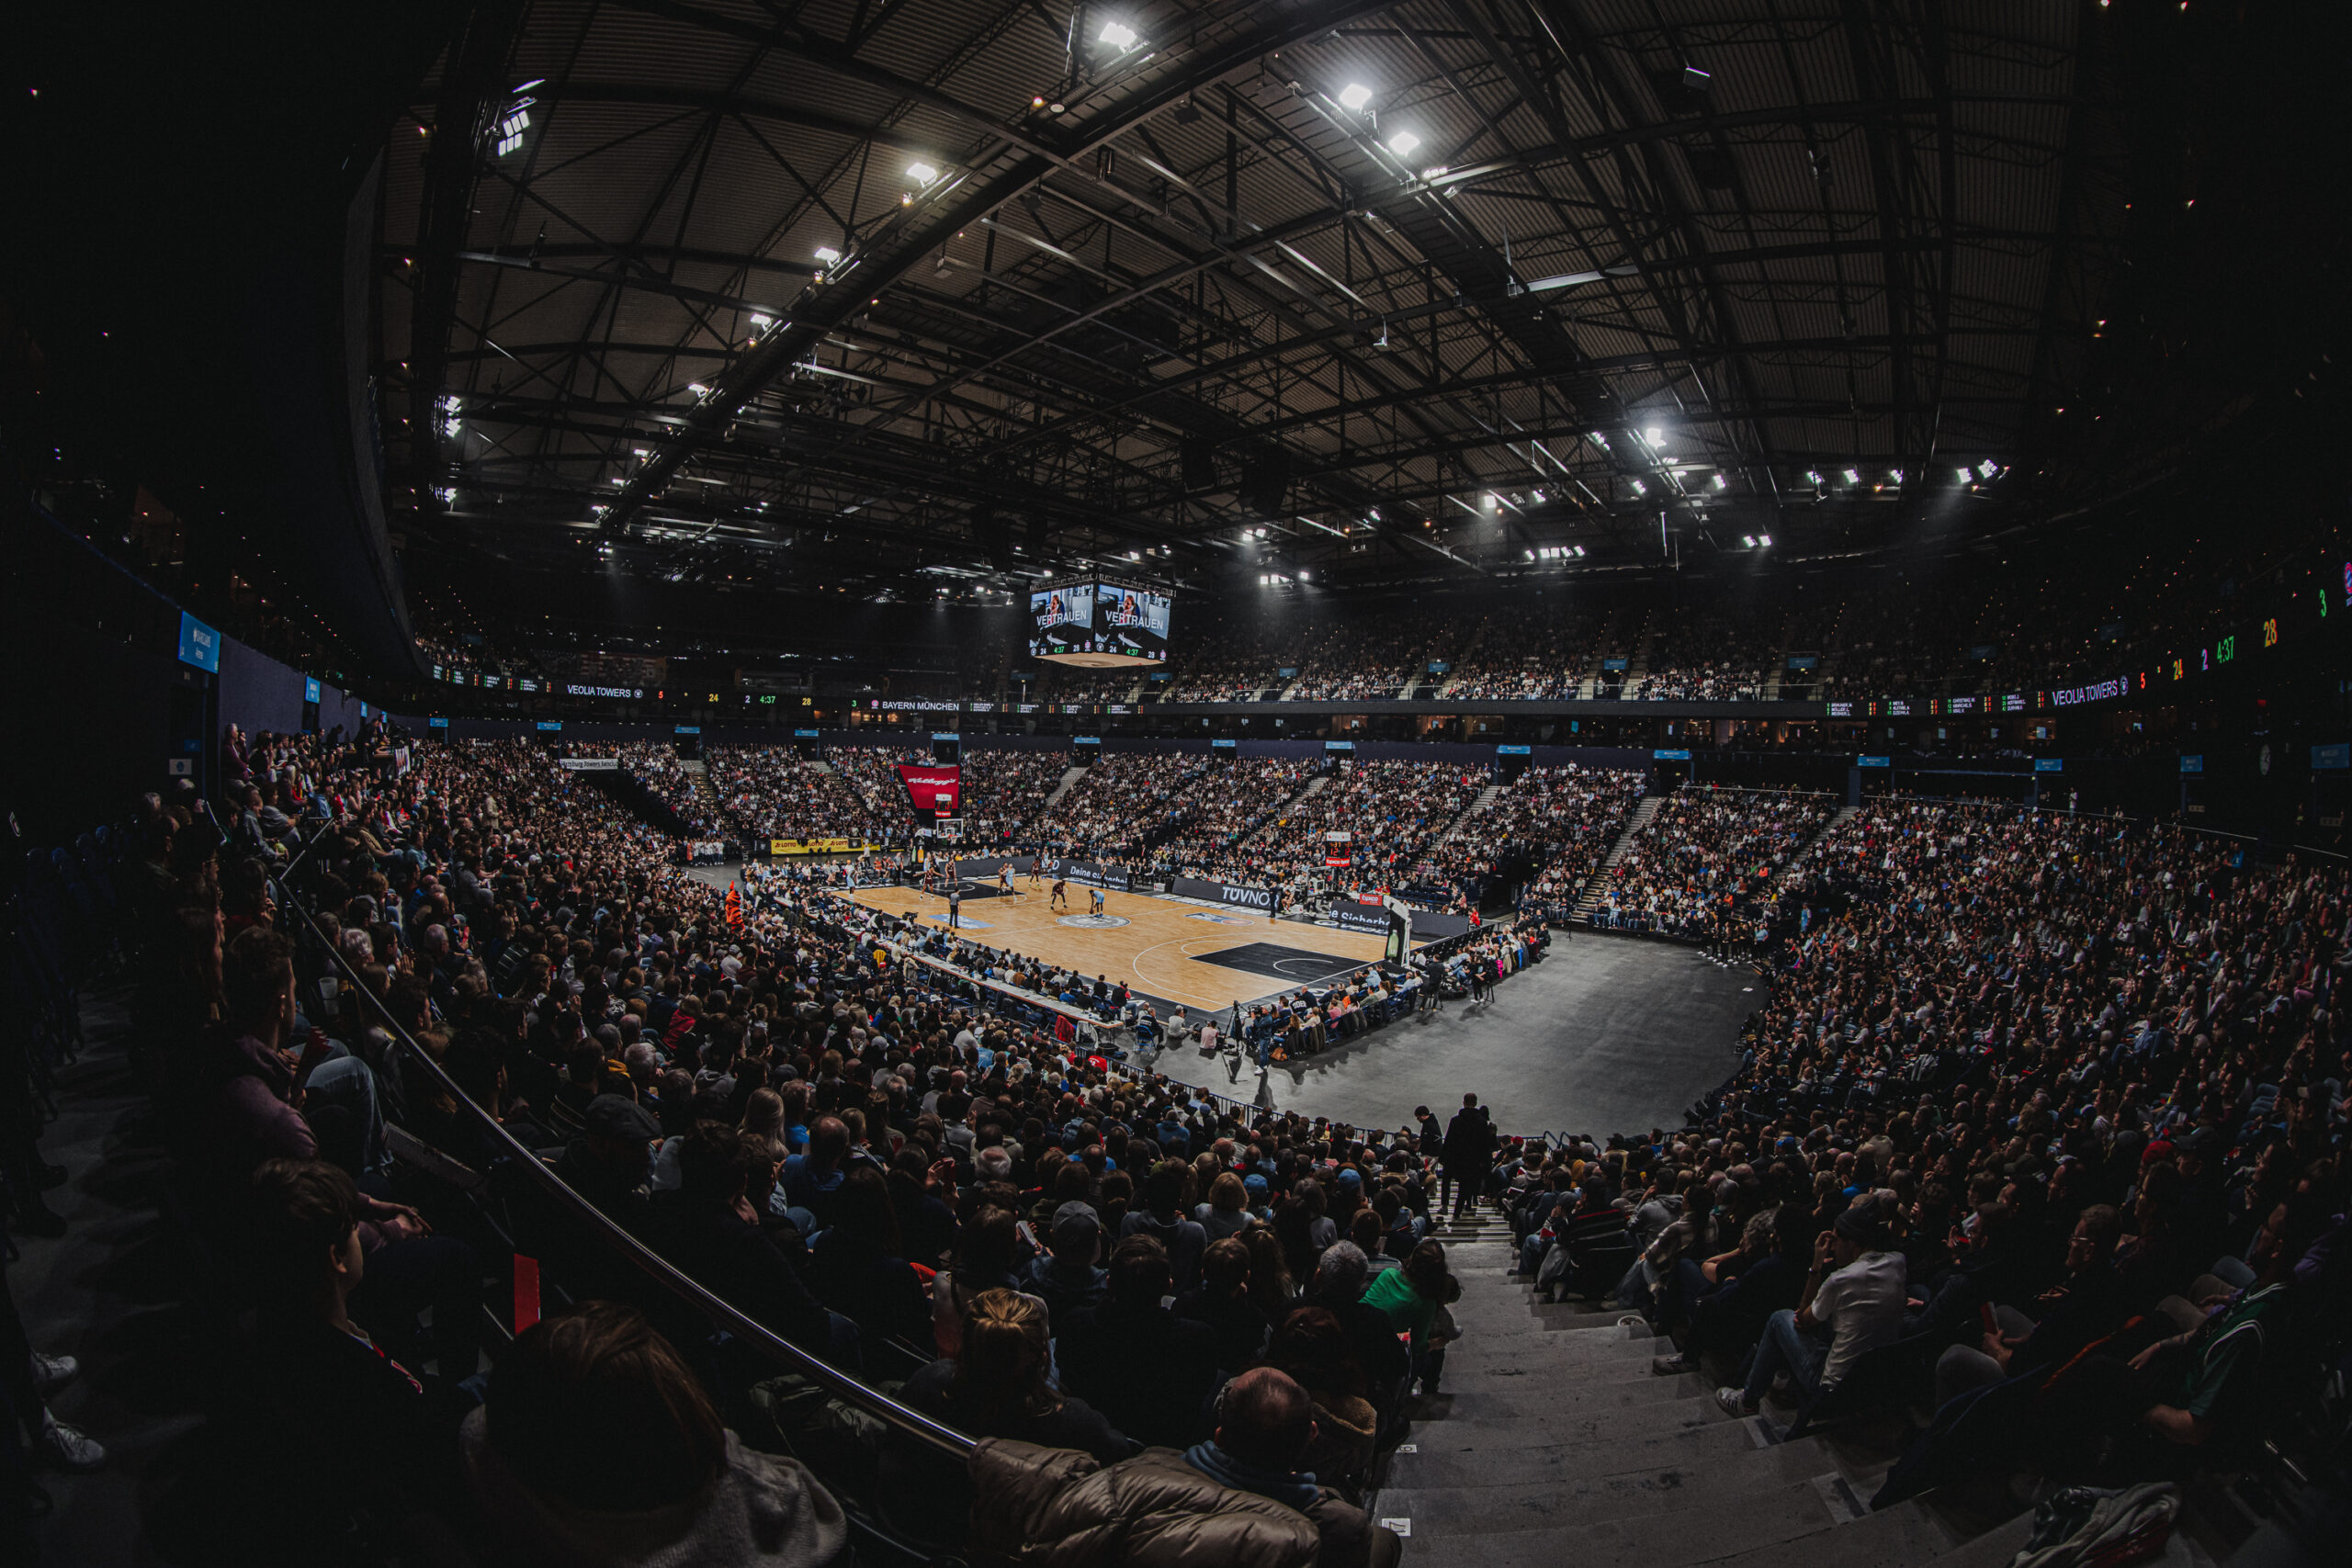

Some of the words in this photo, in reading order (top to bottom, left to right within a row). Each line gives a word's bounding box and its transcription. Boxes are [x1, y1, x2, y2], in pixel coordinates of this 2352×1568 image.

[2319, 589, 2327, 617] 3
[1036, 610, 1087, 626] VERTRAUEN
[1105, 610, 1163, 630] VERTRAUEN
[2263, 617, 2278, 648] 28
[1054, 646, 1065, 654] 4:37
[1109, 646, 1117, 654] 24
[1125, 649, 1138, 657] 4:37
[2217, 635, 2234, 664] 4:37
[2201, 649, 2208, 671] 2
[2173, 658, 2184, 681] 24
[2140, 671, 2146, 689] 5
[567, 684, 595, 696] VEOLIA
[596, 686, 631, 698] TOWERS
[658, 691, 663, 699] 5
[2052, 687, 2086, 705] VEOLIA
[2086, 680, 2119, 702] TOWERS
[708, 694, 719, 703] 24
[744, 695, 751, 704] 2
[759, 695, 776, 704] 4:37
[802, 697, 812, 706] 28
[882, 701, 915, 710] BAYERN
[917, 701, 959, 711] MÜNCHEN
[1070, 866, 1091, 877] Deine
